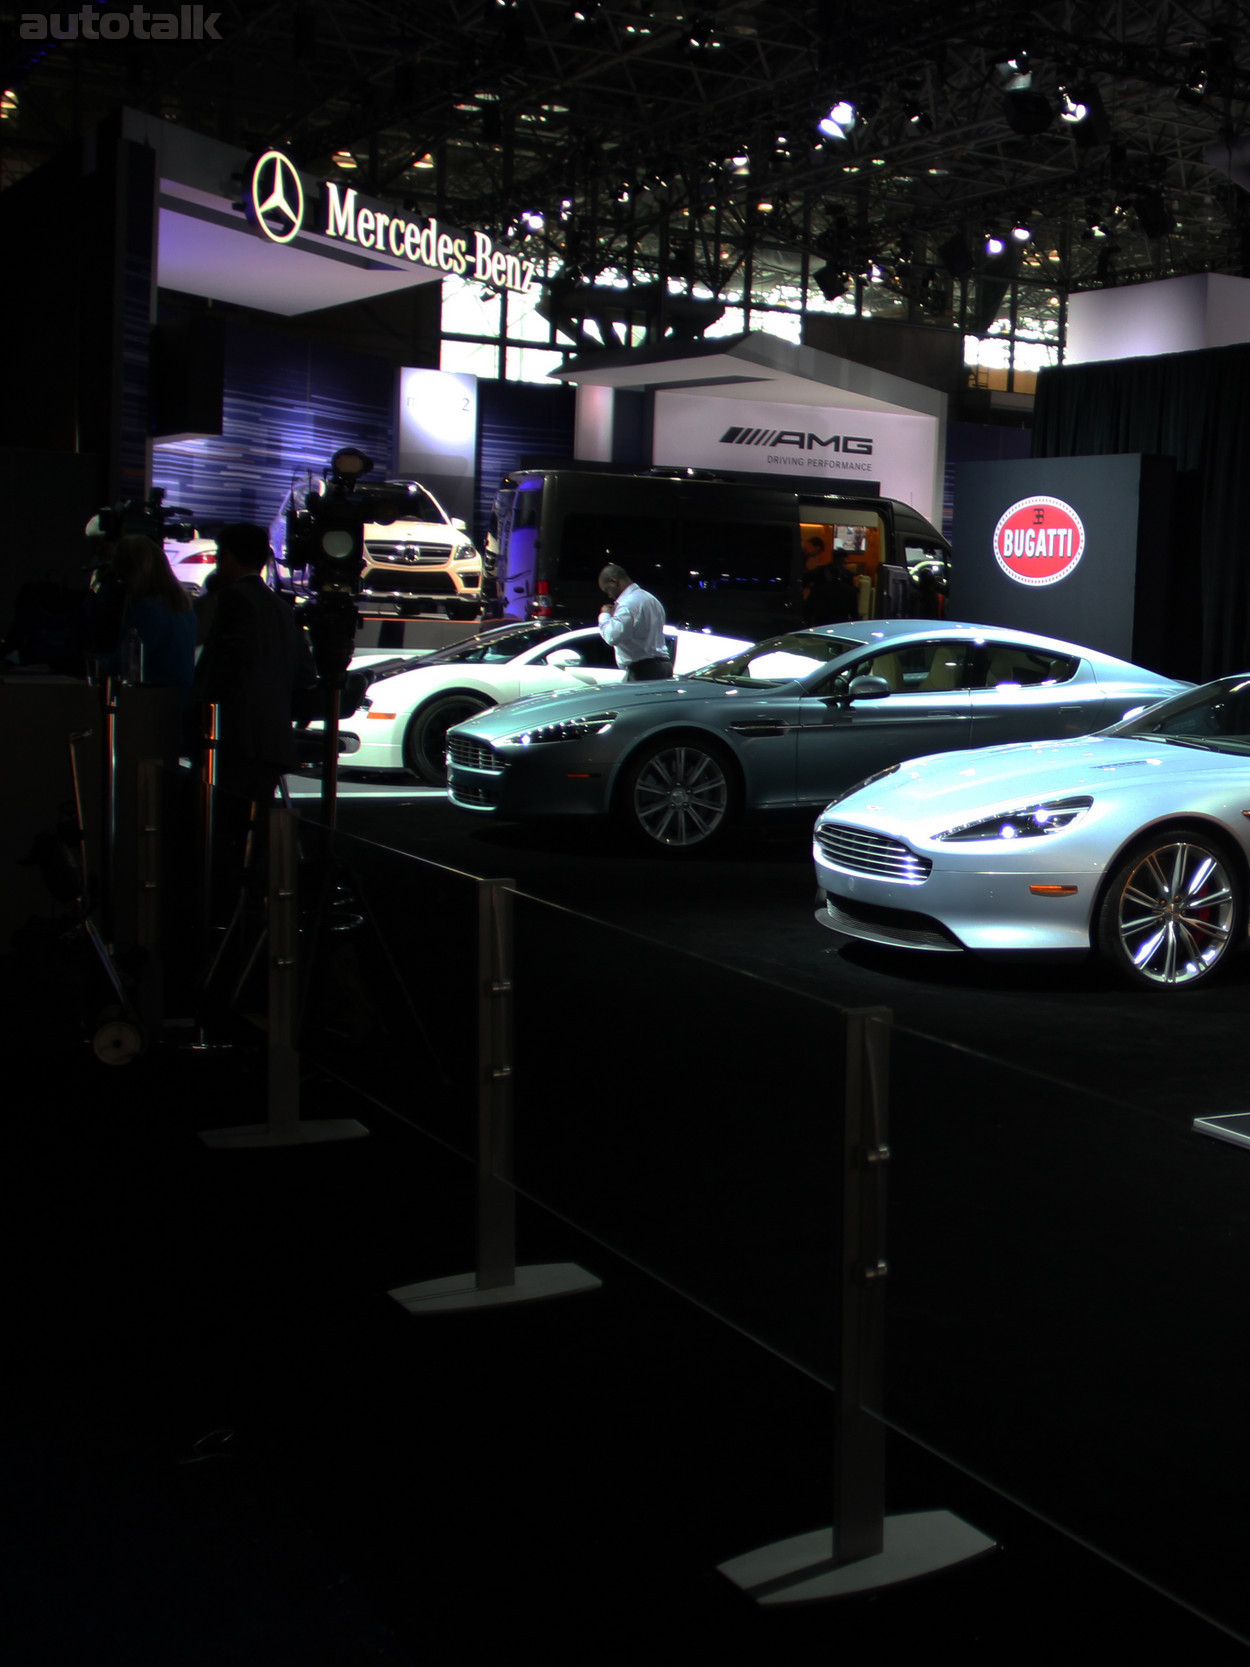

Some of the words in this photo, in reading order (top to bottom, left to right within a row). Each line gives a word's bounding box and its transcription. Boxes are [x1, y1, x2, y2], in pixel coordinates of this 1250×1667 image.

[325, 180, 536, 293] Mercedes-Benz
[767, 455, 804, 466] DRIVING
[807, 458, 872, 472] PERFORMANCE
[1003, 528, 1073, 558] BUGATTI
